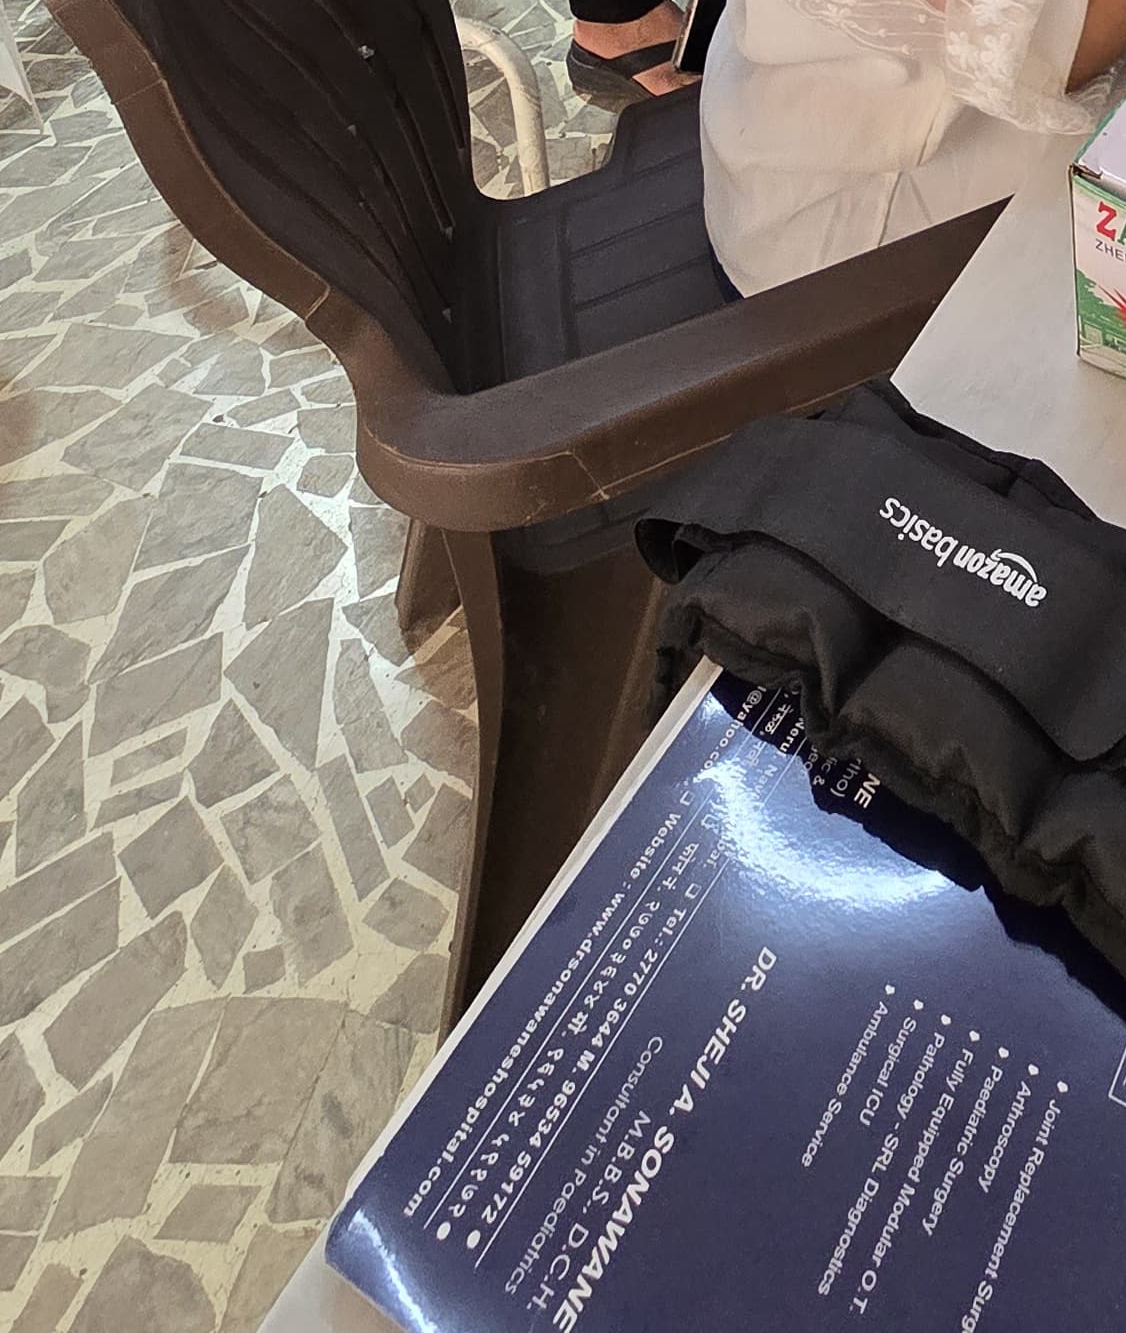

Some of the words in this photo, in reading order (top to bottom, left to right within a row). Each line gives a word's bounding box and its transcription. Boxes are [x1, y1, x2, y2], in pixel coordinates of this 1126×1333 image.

[880, 497, 958, 567] basics
[953, 545, 1047, 607] amazon
[627, 812, 683, 878] Website
[624, 949, 660, 997] 2770
[740, 945, 778, 992] DR.
[402, 892, 624, 1220] www.drsonawaneshospital.com
[590, 996, 627, 1049] 3644
[690, 998, 747, 1091] SHEJI
[836, 1001, 890, 1098] Ambulance
[877, 1015, 918, 1090] Surgical
[572, 1049, 596, 1075] M.
[598, 1035, 664, 1134] Consultant
[668, 1083, 696, 1115] A.
[896, 1032, 946, 1121] Pathology
[946, 1047, 974, 1093] Fully
[529, 1078, 576, 1147] 96534
[802, 1097, 843, 1169] Service
[858, 1088, 884, 1127] ICU
[907, 1091, 954, 1183] Equipped
[957, 1064, 1004, 1155] Paediatric
[977, 1081, 1032, 1194] Arthroscopy
[1036, 1098, 1062, 1147] Joint
[480, 1151, 532, 1227] 59172
[580, 1145, 600, 1166] in
[872, 1133, 900, 1175] SRL
[504, 1167, 587, 1295] Paediatrics
[552, 1124, 676, 1333] SONAWANE
[872, 1183, 917, 1269] Modular
[922, 1155, 965, 1237] Surgery
[984, 1147, 1046, 1280] Replacement
[526, 1219, 589, 1311] D.C.H.
[817, 1177, 880, 1298] Diagnostics
[849, 1269, 878, 1315] O.T.
